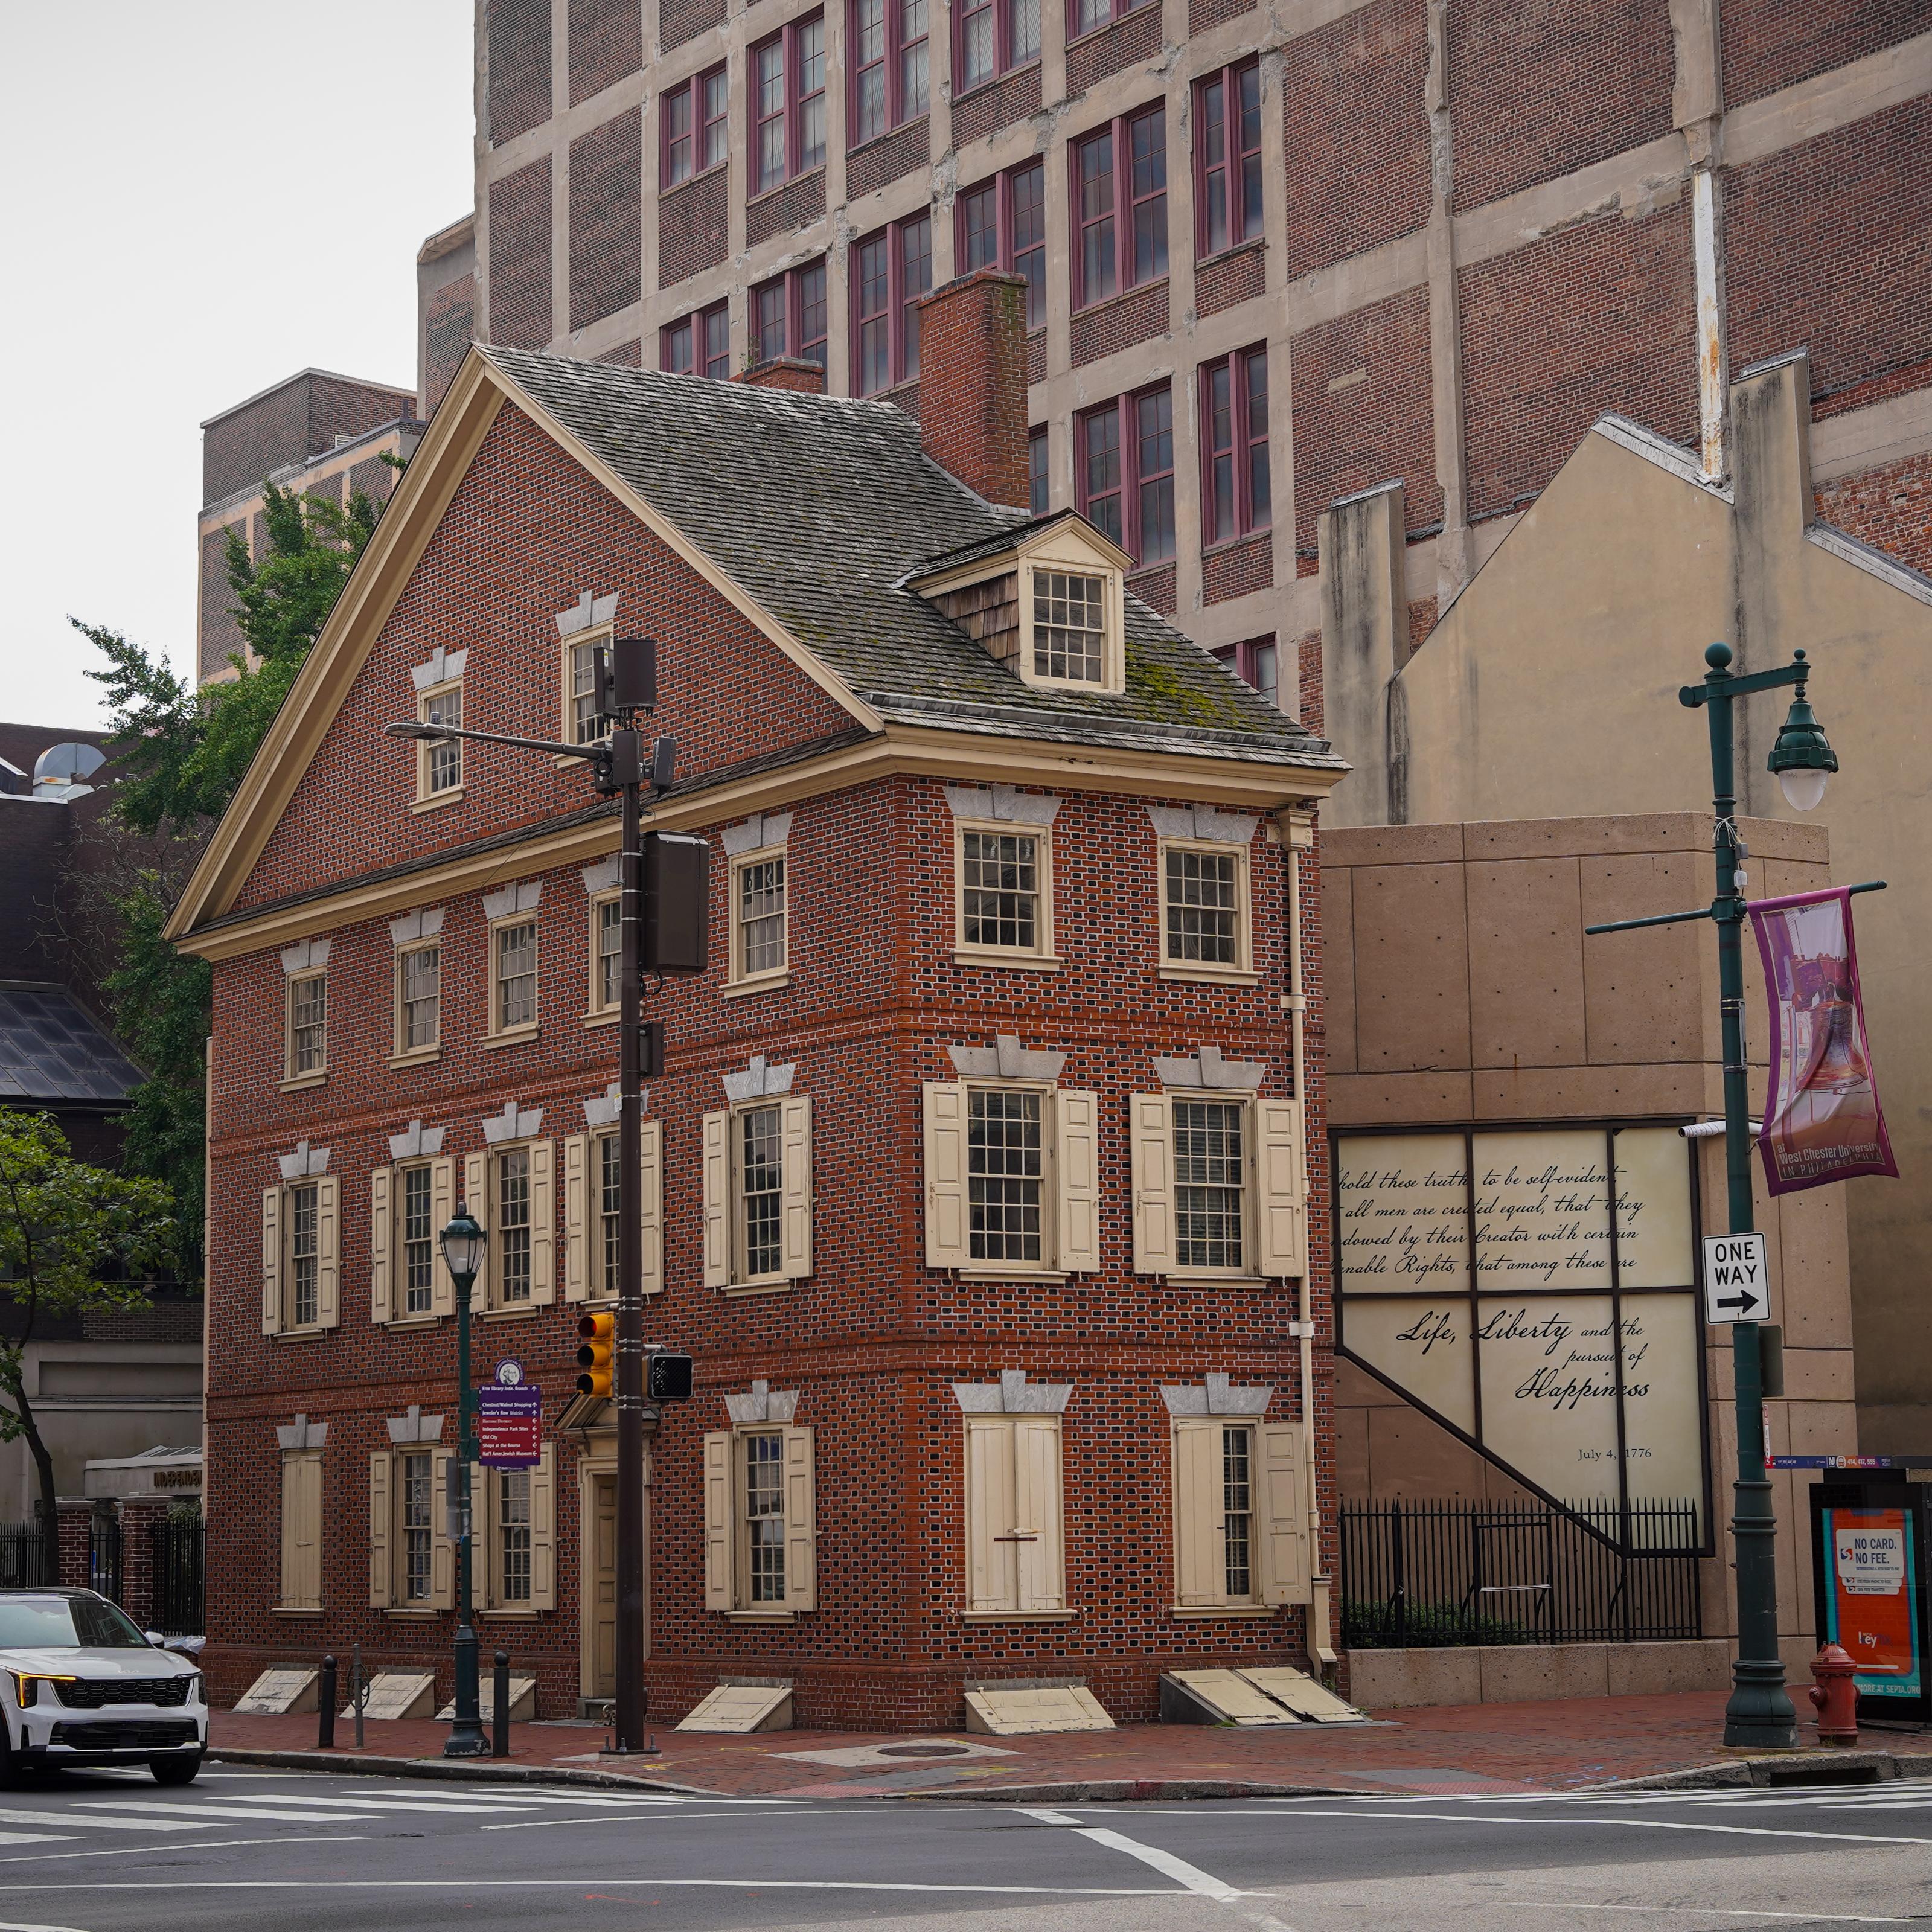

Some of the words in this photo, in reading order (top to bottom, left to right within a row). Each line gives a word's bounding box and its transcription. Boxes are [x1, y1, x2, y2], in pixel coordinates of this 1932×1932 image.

[1777, 1143, 1785, 1154] at
[1779, 1151, 1802, 1165] West
[1804, 1147, 1837, 1162] Chester
[1838, 1142, 1880, 1157] University
[1782, 1166, 1795, 1177] IN
[1800, 1152, 1882, 1174] PHILADELPHIA
[1339, 1171, 1378, 1189] hold
[1378, 1169, 1419, 1188] these
[1424, 1170, 1474, 1187] truth
[1482, 1169, 1502, 1186] to
[1505, 1166, 1522, 1185] be
[1345, 1199, 1374, 1217] all
[1375, 1208, 1408, 1217] men
[1442, 1196, 1500, 1215] created
[1500, 1194, 1549, 1221] equal,
[1553, 1193, 1602, 1212] that
[1604, 1192, 1646, 1221] they
[1399, 1225, 1421, 1255] by
[1425, 1225, 1468, 1243] their
[1476, 1224, 1532, 1244] Creator
[1537, 1222, 1581, 1241] with
[1584, 1223, 1639, 1240] certain
[1715, 1241, 1755, 1262] ONE
[1395, 1253, 1459, 1284] Rights,
[1465, 1252, 1512, 1271] that
[1507, 1259, 1561, 1281] among
[1565, 1250, 1607, 1267] these
[1715, 1264, 1758, 1285] WAY
[1396, 1310, 1456, 1355] Life,
[1469, 1308, 1573, 1356] Liberty
[1580, 1320, 1614, 1337] and
[1619, 1317, 1646, 1336] the
[1628, 1343, 1648, 1370] of
[1515, 1367, 1650, 1410] Happiness
[1578, 1448, 1601, 1462] July
[1606, 1449, 1617, 1461] 4,
[1624, 1448, 1652, 1459] 1776
[1855, 1538, 1867, 1549] NO
[1870, 1538, 1897, 1550] CARD.
[1855, 1553, 1868, 1564] NO
[1871, 1553, 1890, 1564] FEE.
[1886, 1685, 1921, 1694] SEPTA.ORG
